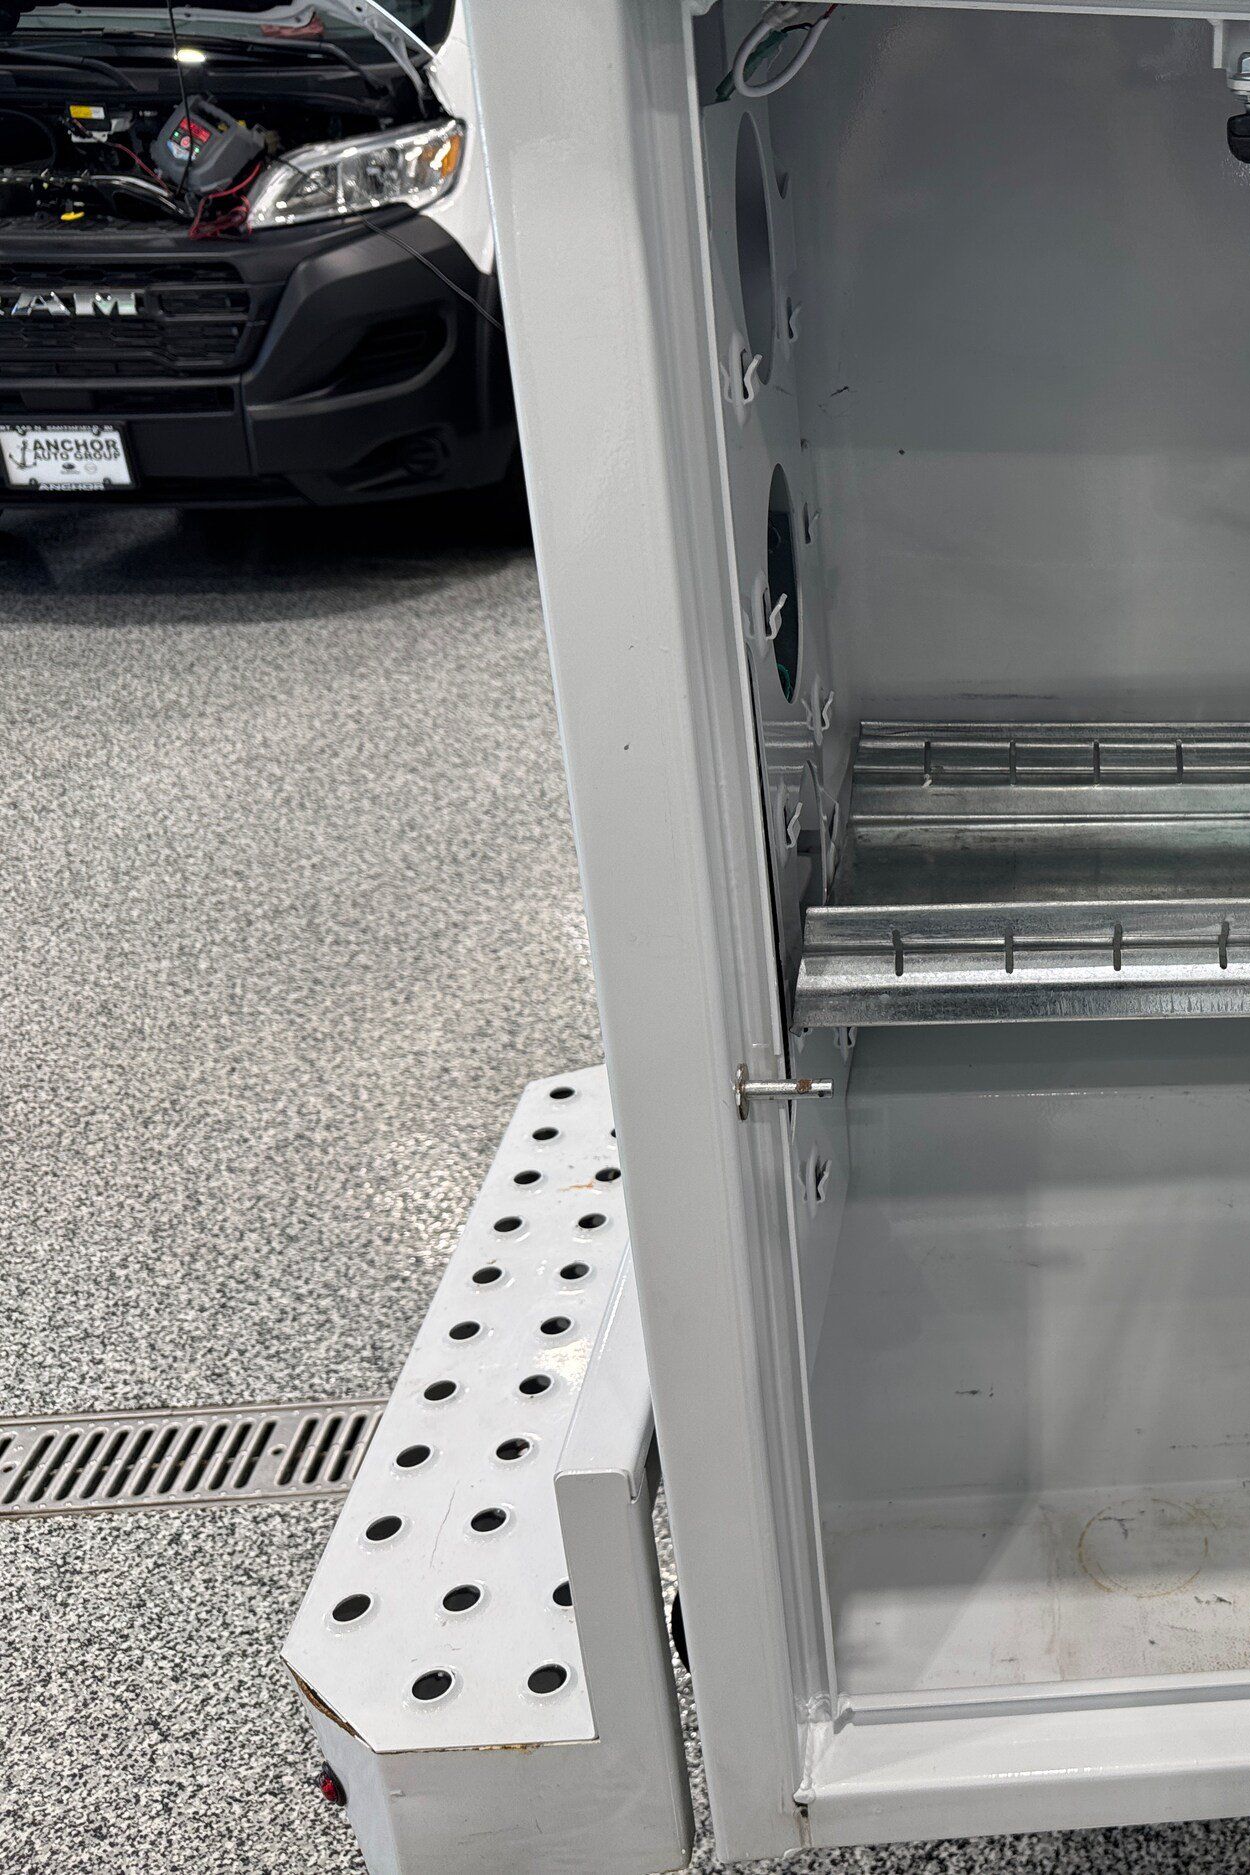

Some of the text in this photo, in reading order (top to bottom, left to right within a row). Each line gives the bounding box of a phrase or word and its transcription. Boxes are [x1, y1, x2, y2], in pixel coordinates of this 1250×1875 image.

[0, 291, 137, 316] AM
[33, 439, 118, 452] ANCHOR
[34, 450, 120, 461] AUTO GROUP
